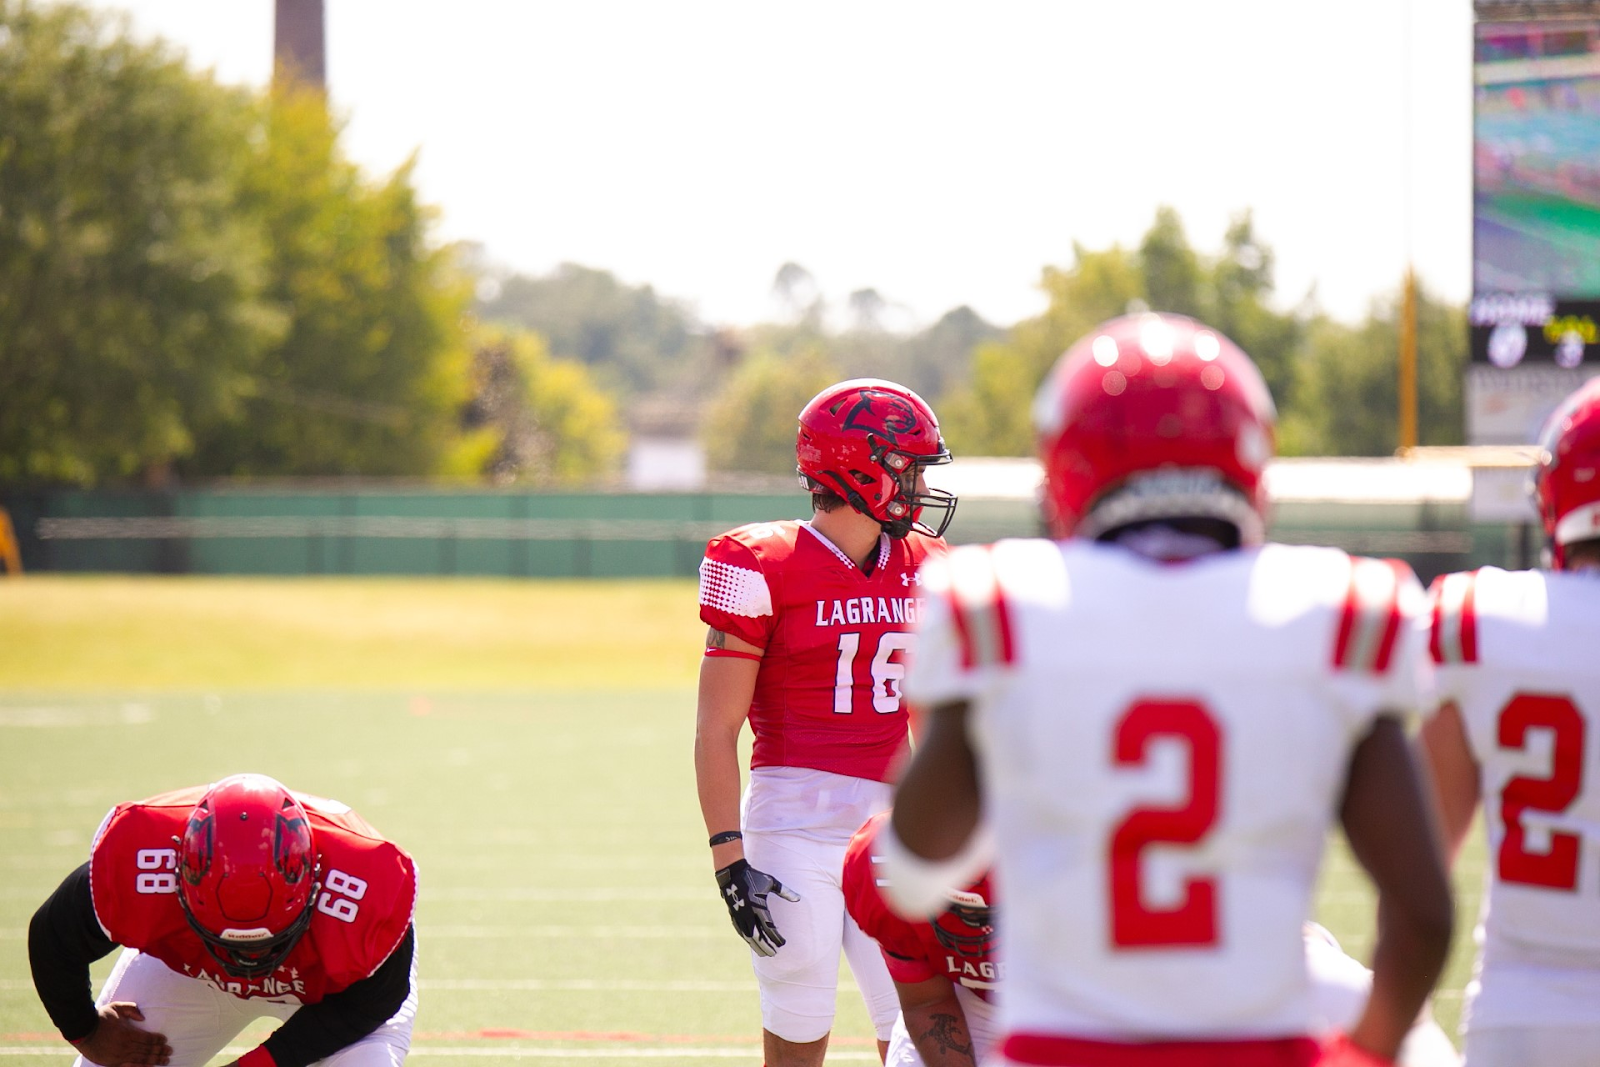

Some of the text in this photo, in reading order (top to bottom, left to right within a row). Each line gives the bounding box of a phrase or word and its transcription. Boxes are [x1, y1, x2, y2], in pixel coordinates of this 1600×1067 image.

[833, 631, 918, 714] 16
[1110, 695, 1222, 951] 2
[136, 848, 177, 894] 68
[317, 868, 368, 923] 68
